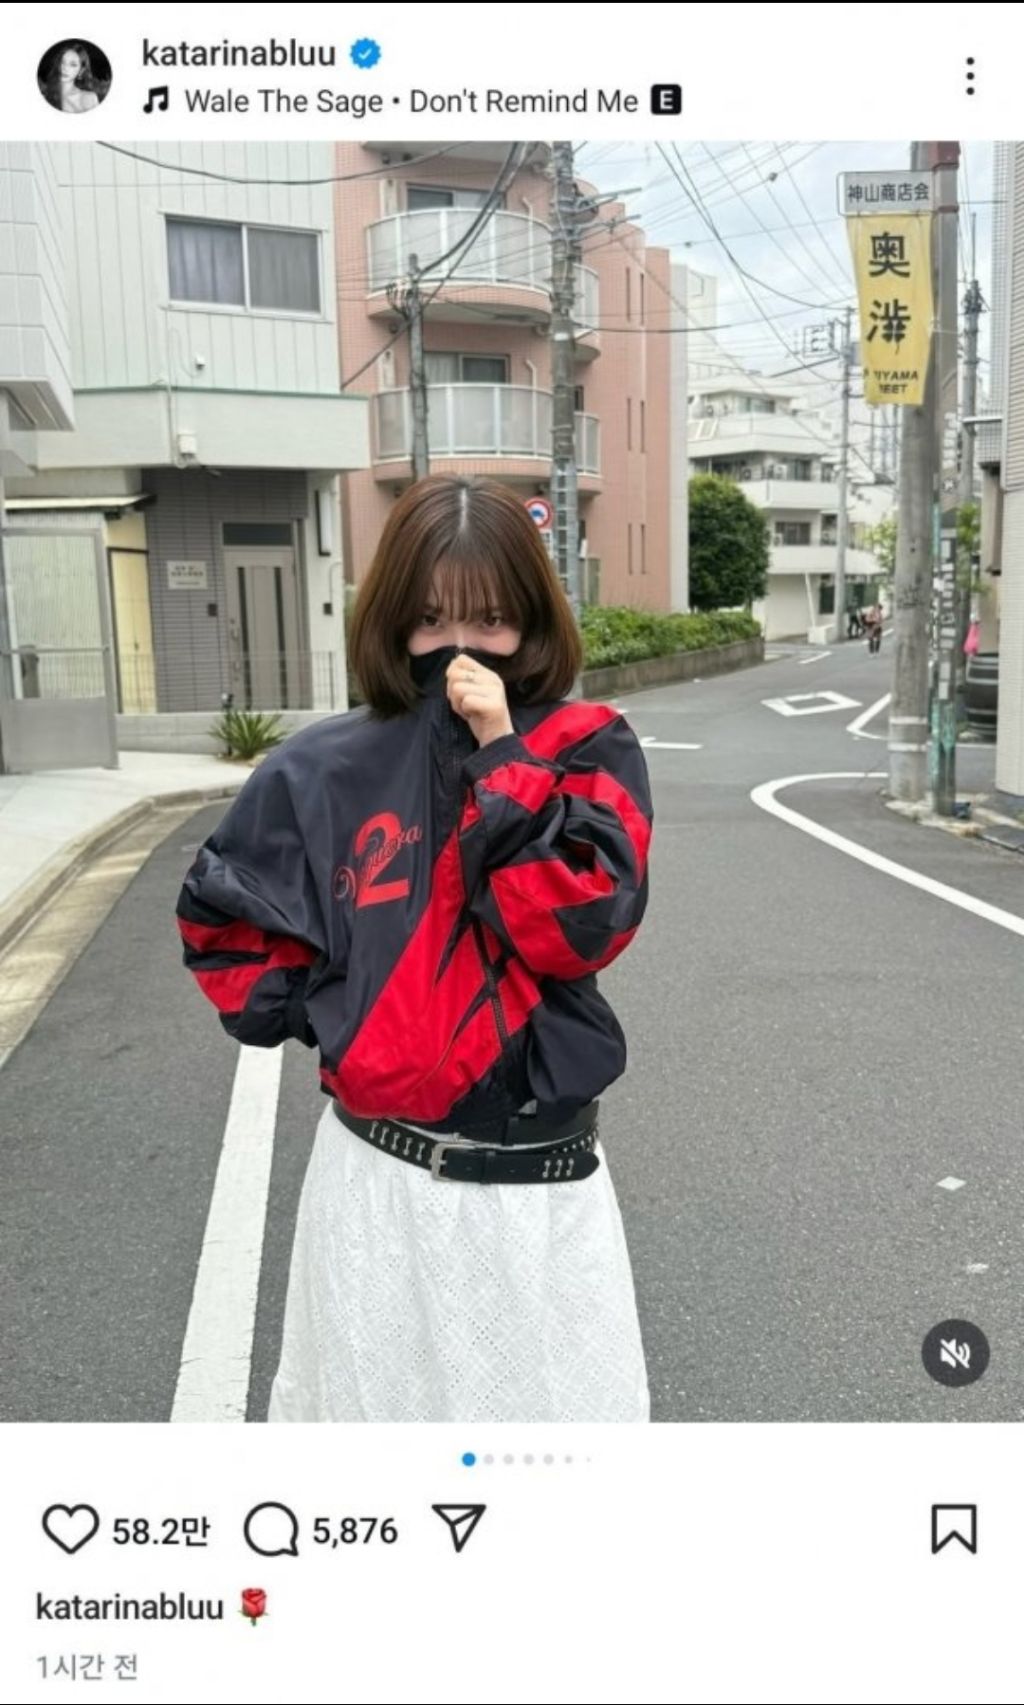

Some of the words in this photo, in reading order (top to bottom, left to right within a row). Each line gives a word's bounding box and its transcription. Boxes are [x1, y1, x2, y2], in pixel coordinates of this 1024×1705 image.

[848, 182, 929, 203] 神山商店会
[354, 811, 410, 909] 2
